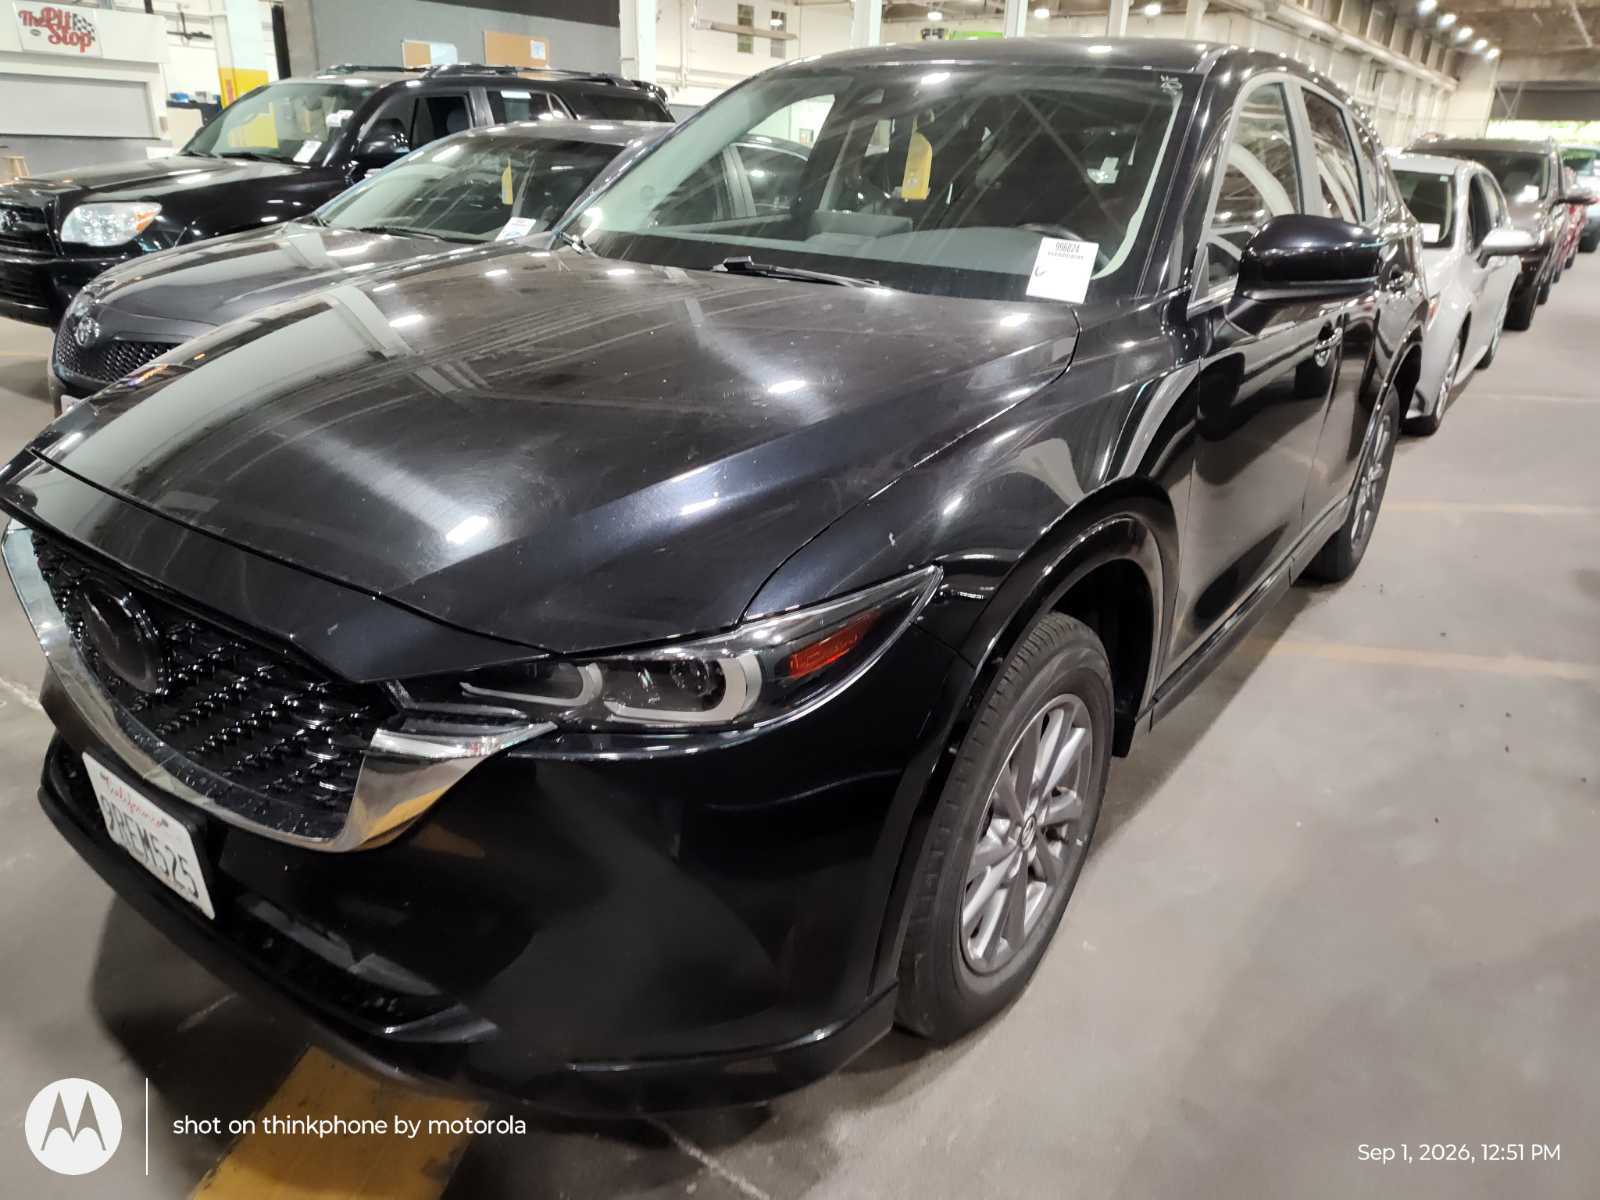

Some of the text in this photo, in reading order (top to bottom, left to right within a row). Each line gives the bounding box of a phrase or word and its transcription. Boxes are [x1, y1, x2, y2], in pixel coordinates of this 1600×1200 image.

[18, 7, 71, 33] The Pit
[48, 31, 92, 53] Stop
